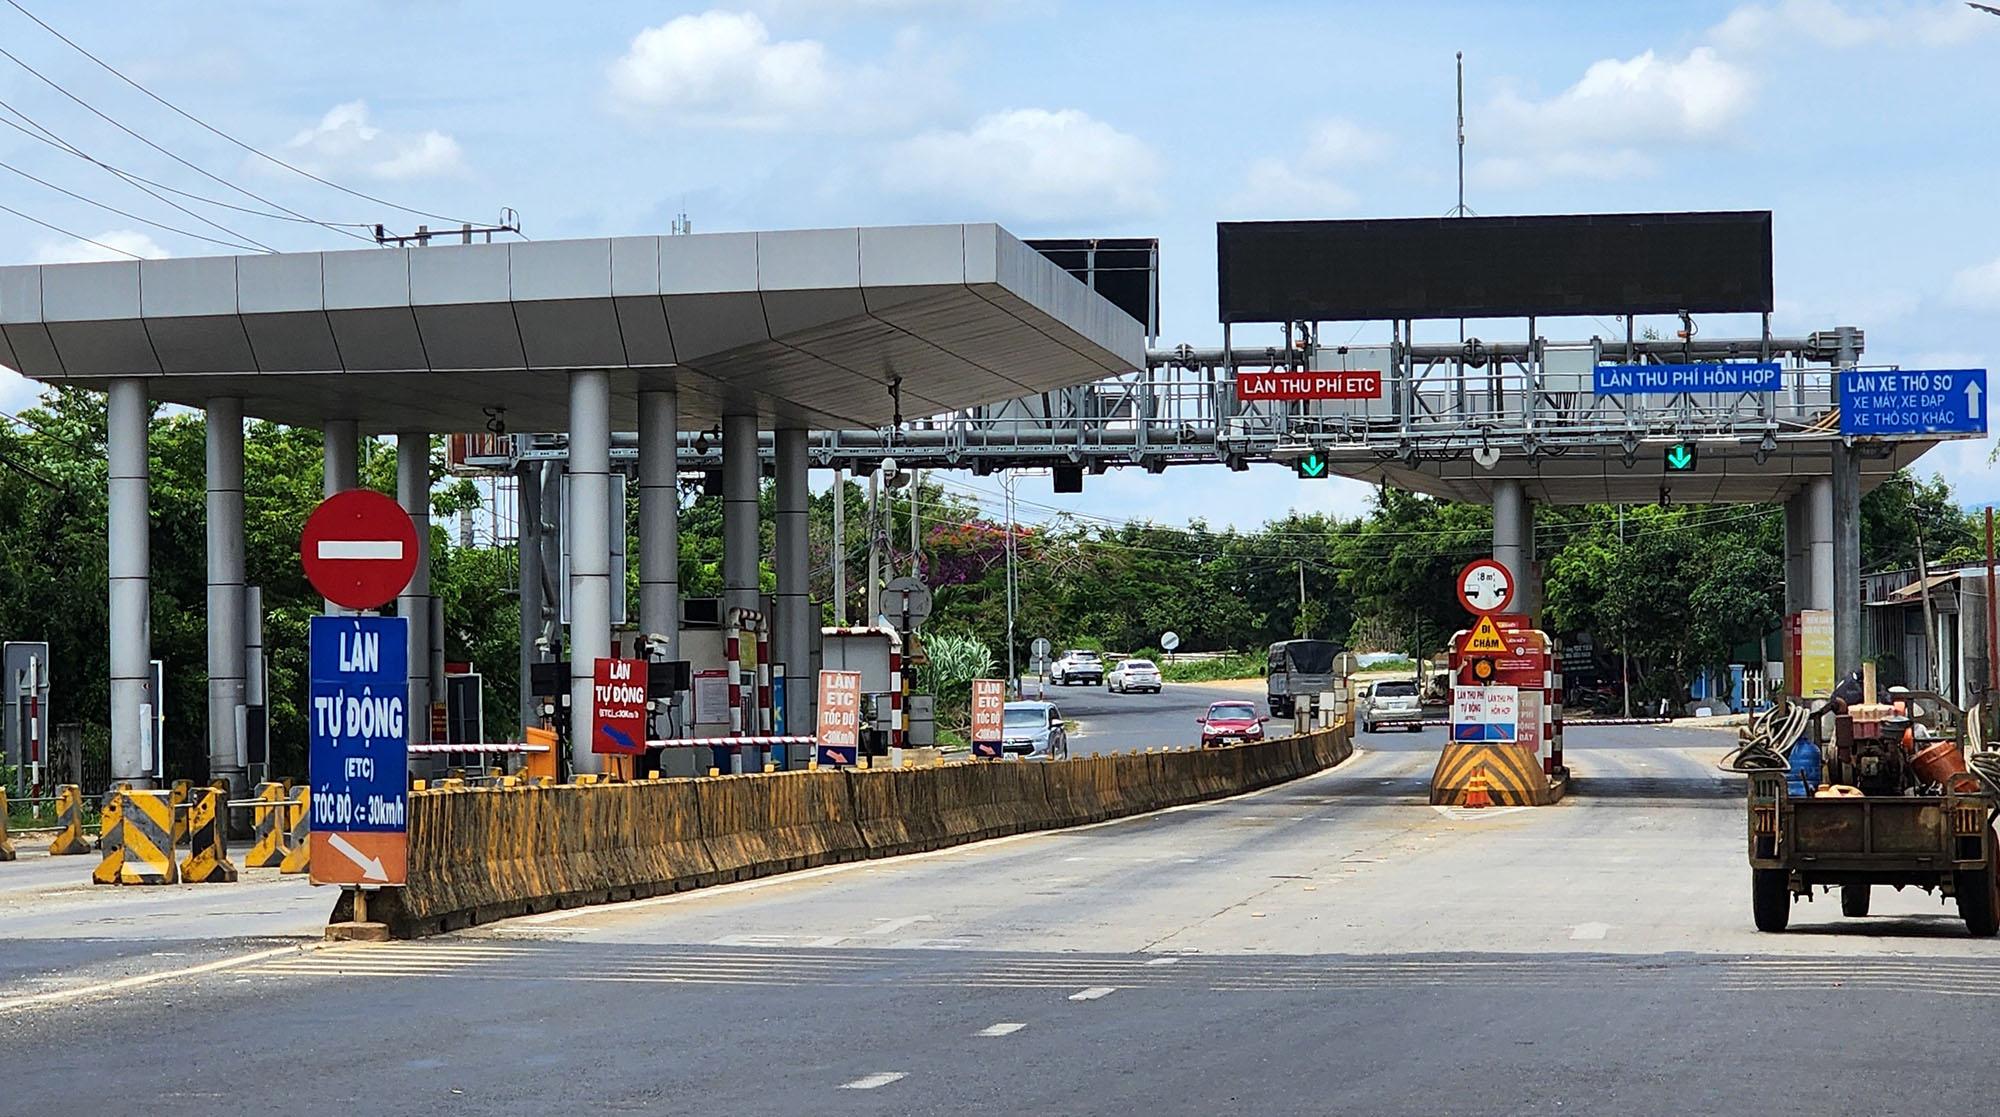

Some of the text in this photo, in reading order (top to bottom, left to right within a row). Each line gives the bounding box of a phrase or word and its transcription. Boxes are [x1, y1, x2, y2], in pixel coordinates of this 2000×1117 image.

[1244, 375, 1375, 394] LÀN THU PHÍ ETC
[1600, 365, 1774, 387] LÀN THU PHÍ HỖN HỢP
[1848, 374, 1875, 393] LÀN
[1879, 376, 1897, 392] XE
[1901, 372, 1929, 391] THÔ
[1853, 397, 1869, 409] XE
[1901, 395, 1917, 408] XE
[1921, 394, 1945, 409] ĐẠP
[1854, 413, 1869, 426] XE
[1922, 409, 1954, 424] KHÁC
[1480, 572, 1486, 581] 8
[1481, 625, 1491, 634] ĐI
[339, 621, 379, 672] LÀN
[1473, 637, 1499, 649] CHẬM
[610, 660, 630, 680] LÀN
[826, 673, 856, 689] LÀN
[978, 681, 1000, 694] LÀN
[595, 683, 644, 707] TỰ ĐỘNG
[827, 692, 854, 706] ETC
[978, 696, 1000, 708] ETC
[314, 689, 344, 748] TỰ
[346, 686, 403, 748] ĐỘNG
[824, 707, 855, 728] TỐC ĐỘ
[976, 710, 990, 724] TỐC
[345, 758, 374, 782] (ETC)
[313, 783, 335, 824] TỐC
[337, 785, 352, 831] ĐỘ
[368, 795, 404, 828] 30km/h
